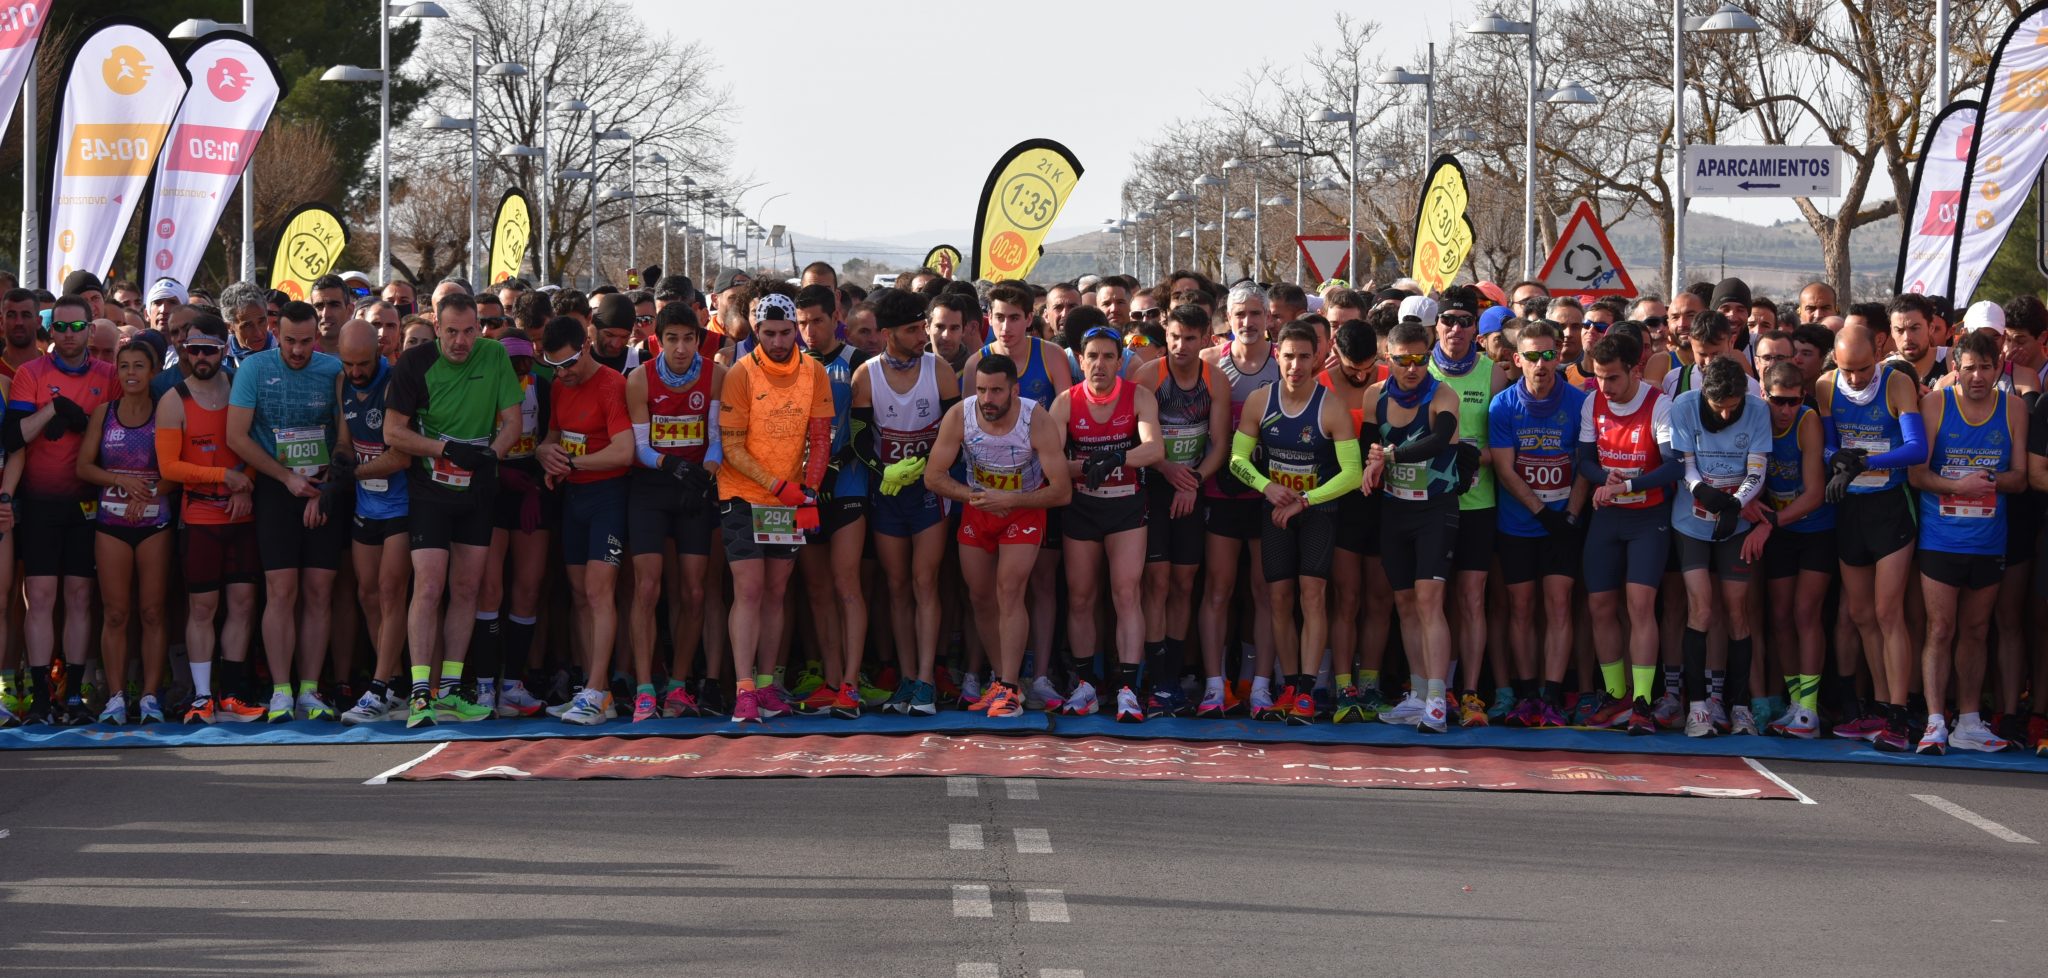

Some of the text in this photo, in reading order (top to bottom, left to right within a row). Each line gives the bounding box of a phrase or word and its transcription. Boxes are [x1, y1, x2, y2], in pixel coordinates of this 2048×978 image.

[1036, 158, 1065, 183] 21 K
[1696, 158, 1830, 177] APARCAMIENTOS
[1010, 183, 1051, 222] 1:35
[1432, 195, 1452, 238] 1:30
[313, 223, 334, 245] 21 K
[293, 240, 326, 275] 1:45
[655, 423, 701, 440] 5411
[1112, 432, 1128, 440] club
[286, 442, 319, 458] 1030
[1173, 439, 1198, 454] 812
[1945, 447, 2003, 455] CONSTRUCCIONES
[1945, 456, 2000, 466] TREXCOM
[976, 467, 1019, 490] 5471
[1270, 470, 1315, 492] 5061
[1525, 466, 1563, 485] 500
[764, 511, 791, 525] 294
